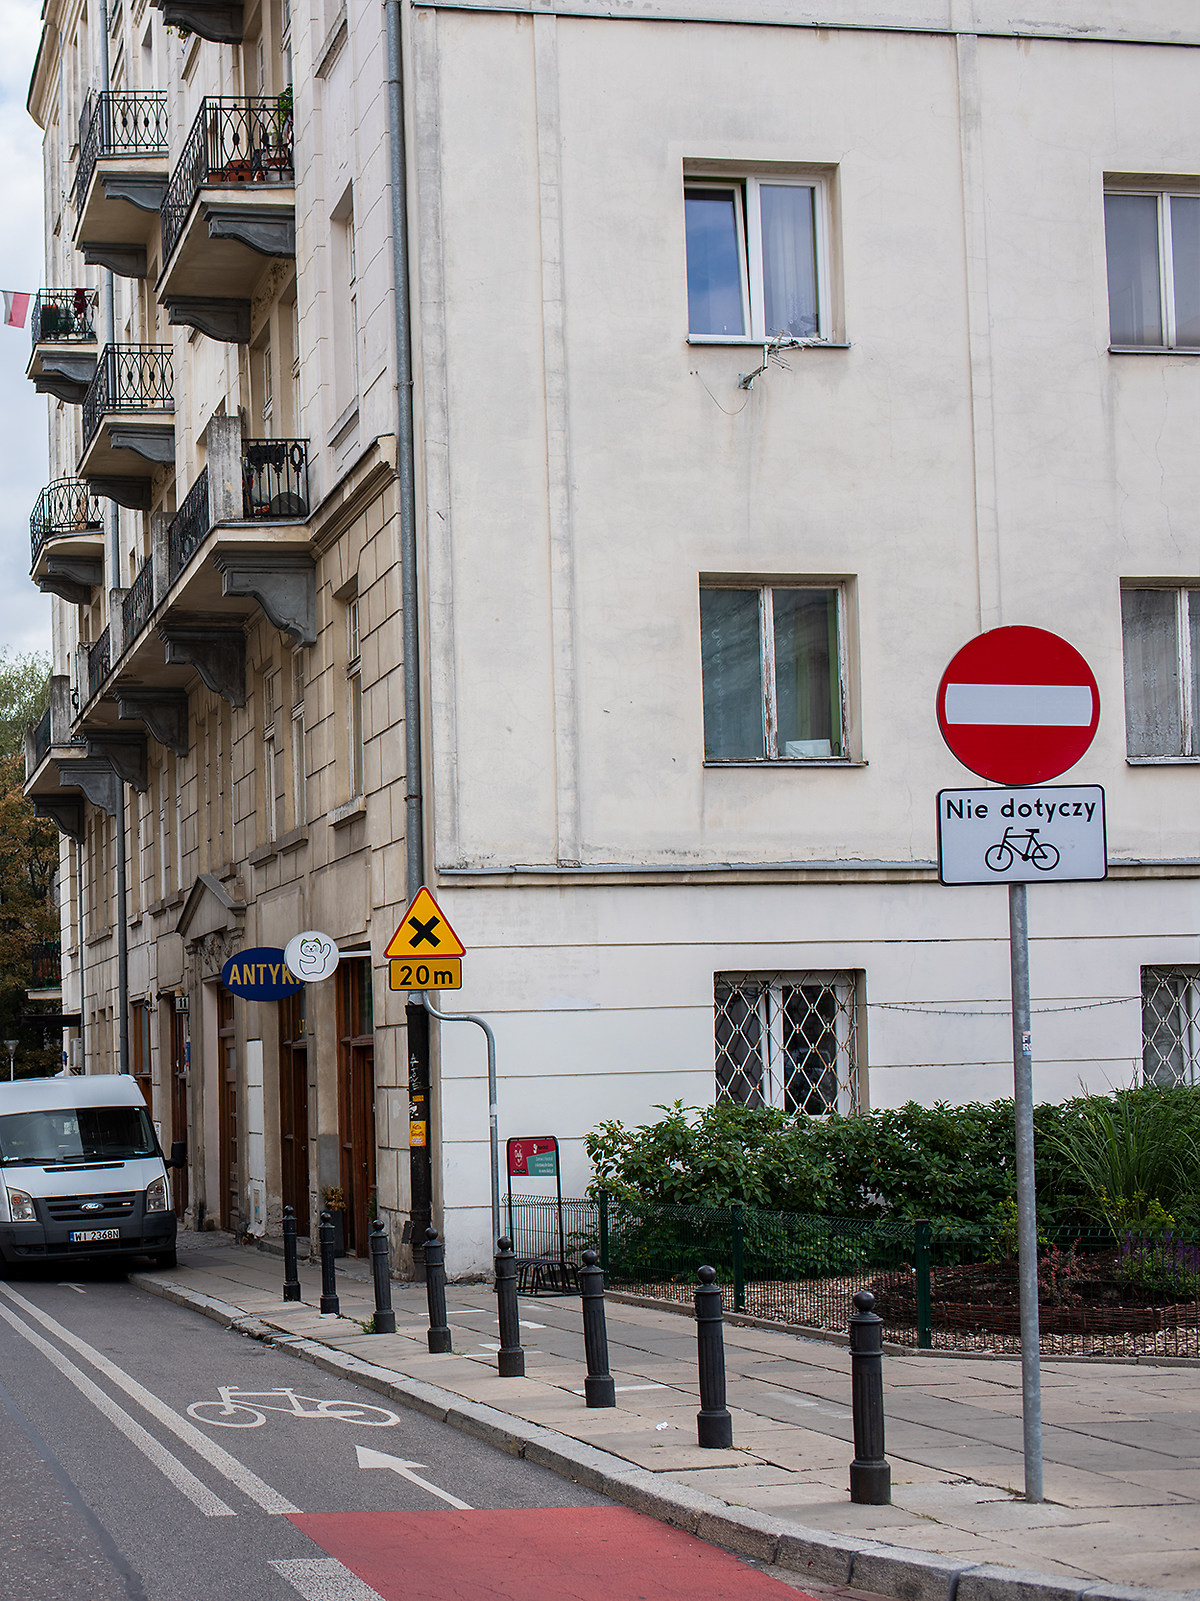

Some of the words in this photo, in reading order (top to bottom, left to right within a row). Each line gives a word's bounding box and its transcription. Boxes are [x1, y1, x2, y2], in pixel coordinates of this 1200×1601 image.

[946, 799, 989, 819] Nie
[1000, 798, 1097, 823] dotyczy
[228, 963, 300, 985] ANTYK
[75, 1232, 86, 1241] WI
[91, 1230, 119, 1240] 2368N
